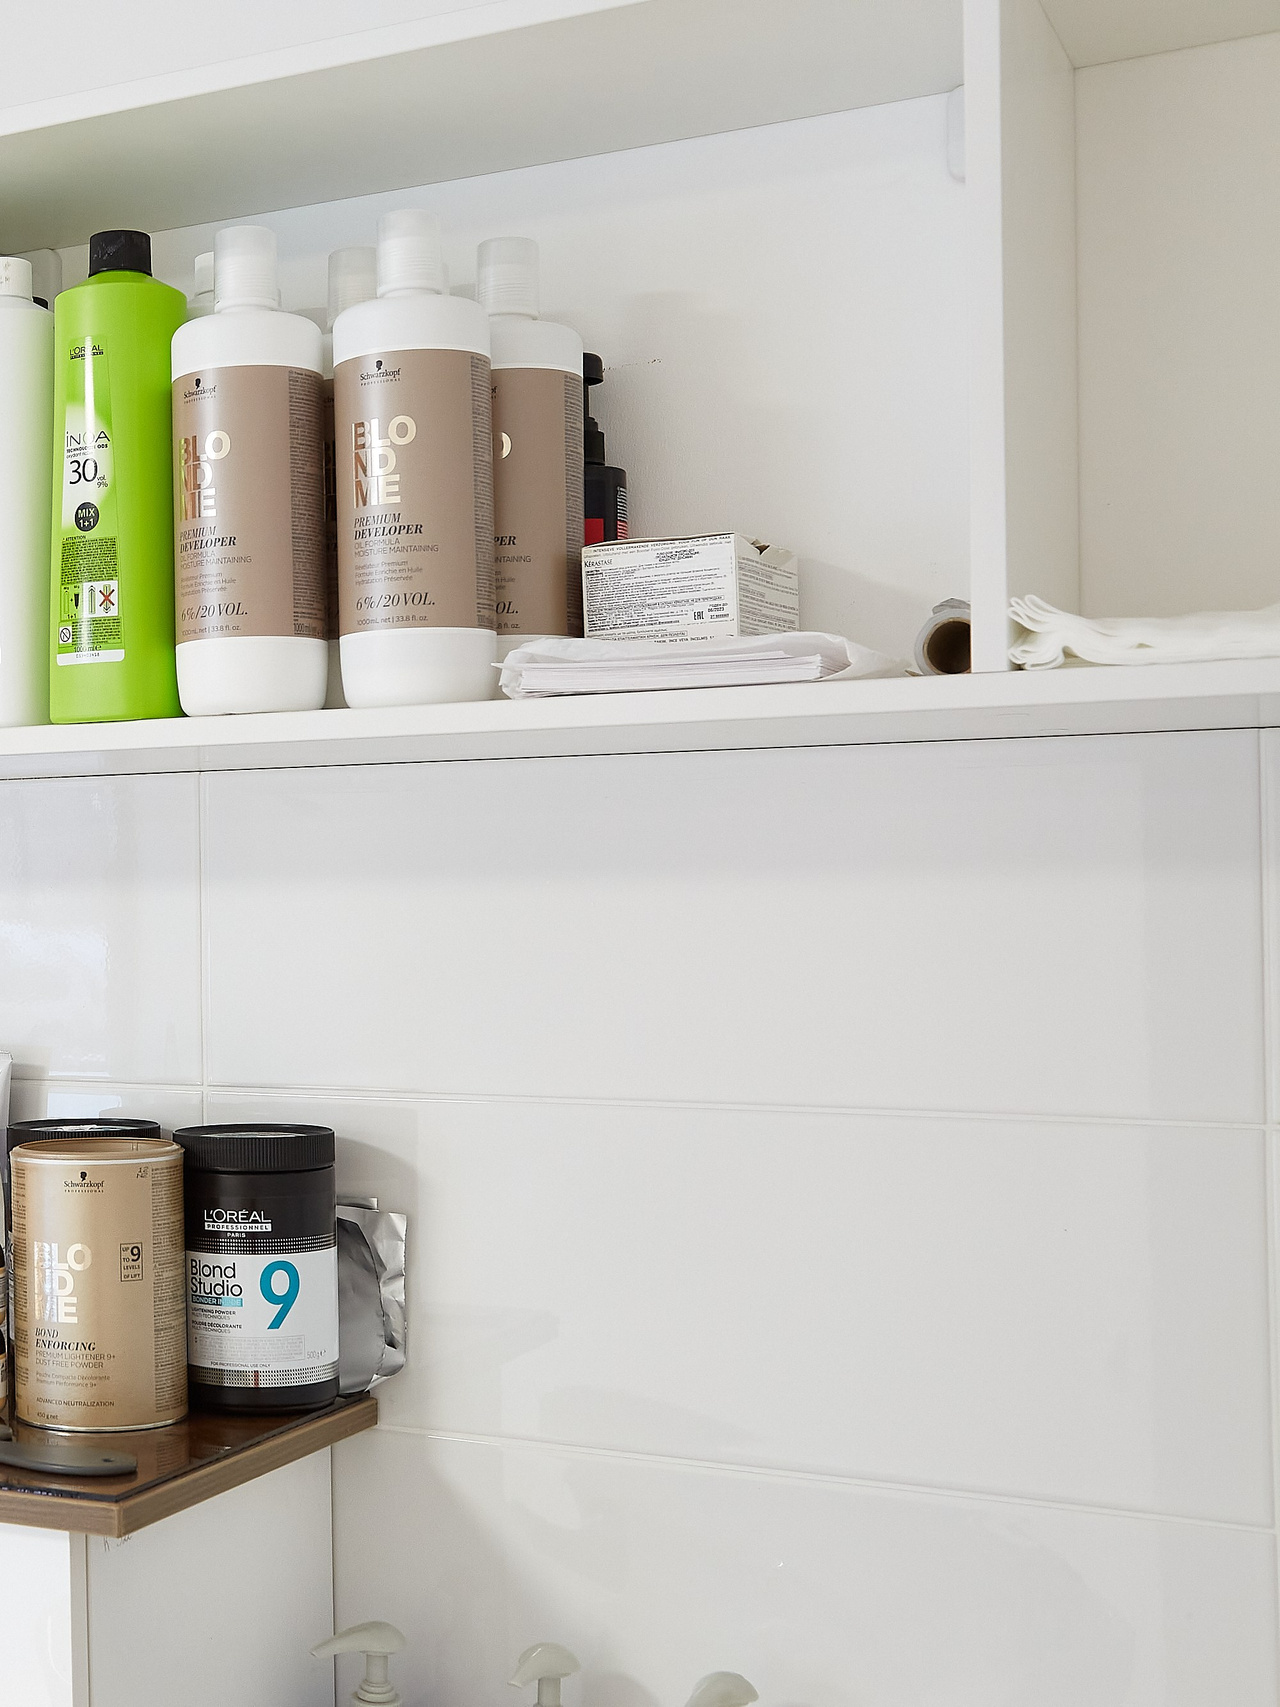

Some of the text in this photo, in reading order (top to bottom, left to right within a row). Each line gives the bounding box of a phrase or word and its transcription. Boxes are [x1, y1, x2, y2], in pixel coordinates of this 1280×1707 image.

[359, 367, 402, 382] Schwarzkopf
[183, 384, 218, 399] Schwarzkopf
[351, 415, 417, 451] BLO
[353, 446, 397, 480] ND
[69, 457, 98, 485] 30
[354, 474, 402, 509] ME
[77, 507, 96, 518] MIX
[353, 512, 401, 528] PREMIUM
[79, 518, 95, 528] 1+1
[180, 525, 217, 542] PREMIUM
[354, 523, 424, 541] DEVELOPER
[180, 536, 237, 554] DEVELOPER
[365, 537, 401, 548] FORMULA
[354, 545, 439, 558] MOISTURE MAINTAINING
[206, 555, 252, 566] MAINTAINING
[356, 591, 436, 611] 6%/20 VOL.
[181, 602, 248, 622] 6%/20 VOL.
[380, 616, 391, 624] net
[395, 615, 411, 623] 33.8
[210, 624, 224, 632] 33.8
[63, 1179, 105, 1190] Schwarzkopf
[204, 1208, 272, 1223] L'ORÉAL
[206, 1223, 270, 1231] PROFESSIONNEL
[33, 1240, 93, 1271] BLO
[130, 1245, 141, 1262] 9
[190, 1258, 236, 1279] Blond
[190, 1276, 243, 1297] Studio
[192, 1295, 218, 1305] BONDER
[259, 1260, 300, 1330] 9
[191, 1307, 215, 1315] LIGHTENING
[34, 1327, 59, 1339] BOND
[35, 1338, 96, 1352] ENFORCING
[35, 1350, 64, 1359] PREMIUM
[64, 1352, 105, 1360] LIGHTENER
[35, 1358, 104, 1369] DUST FREE POWDER
[36, 1396, 115, 1407] ADVANCED NEUTRALIZATION
